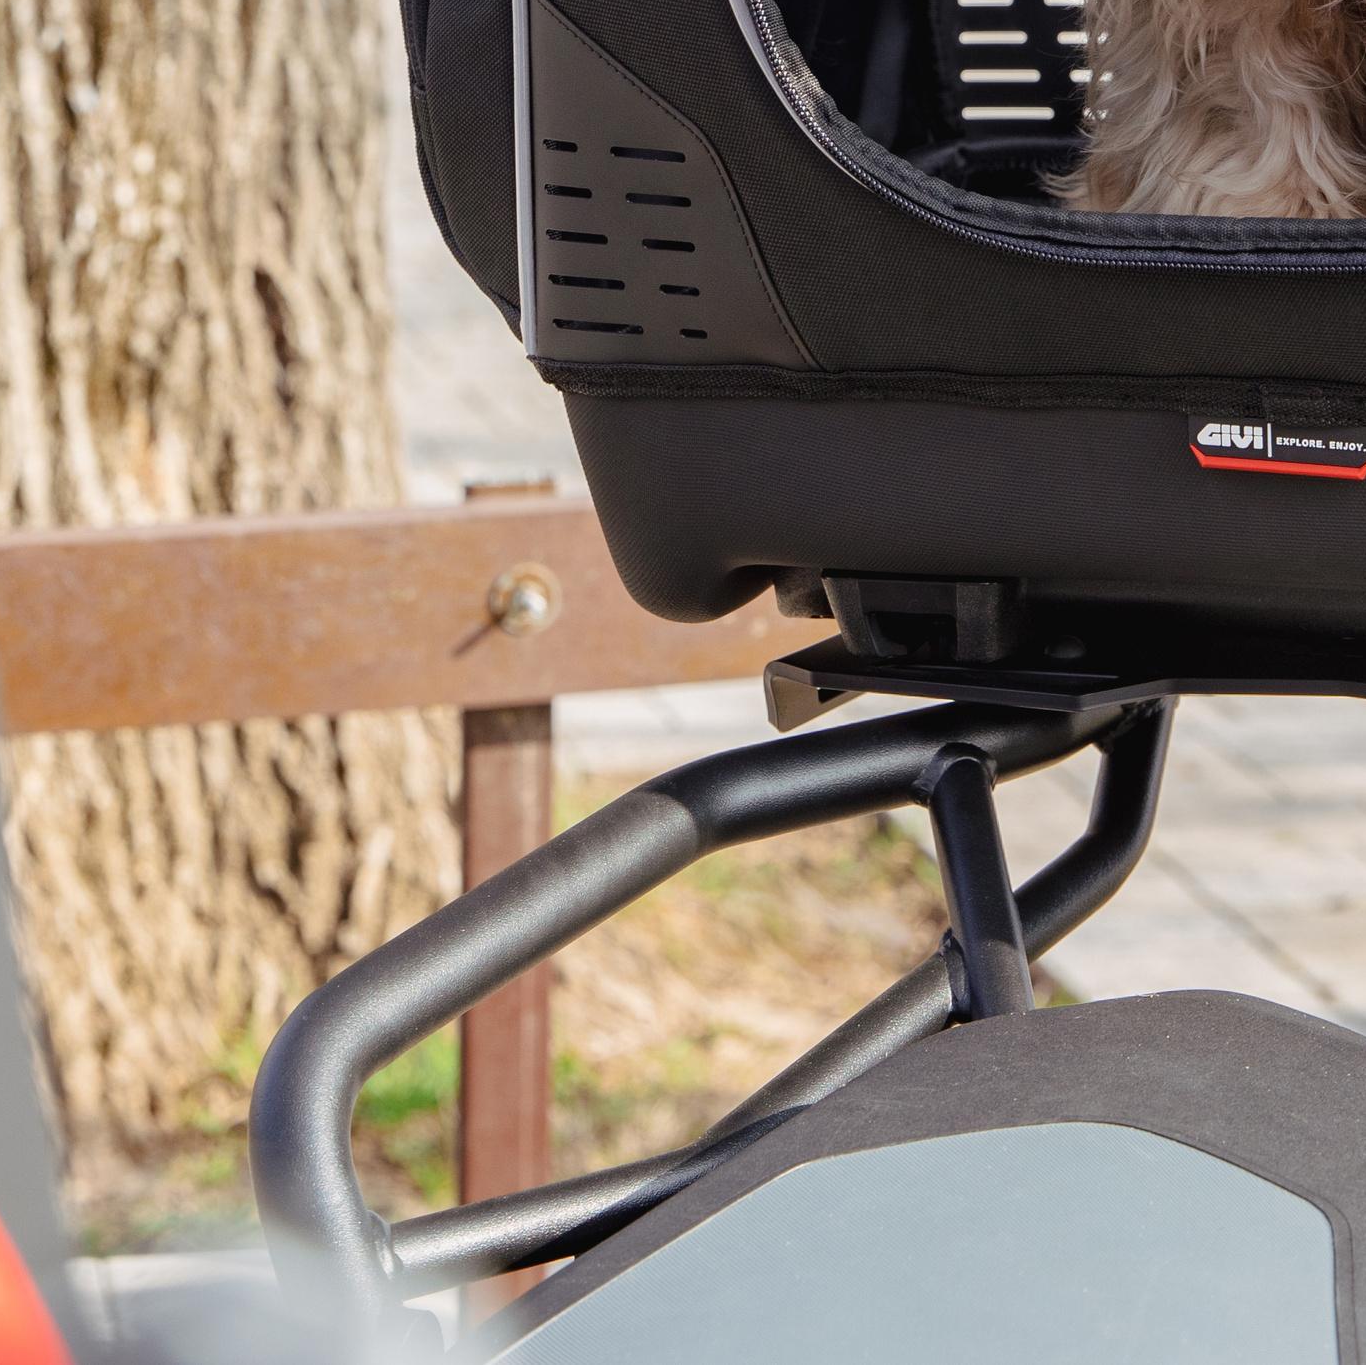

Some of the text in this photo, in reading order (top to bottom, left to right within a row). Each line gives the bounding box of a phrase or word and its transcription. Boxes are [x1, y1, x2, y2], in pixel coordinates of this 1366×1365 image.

[1197, 423, 1366, 452] GIVI EXPLORE. ENJOY.
